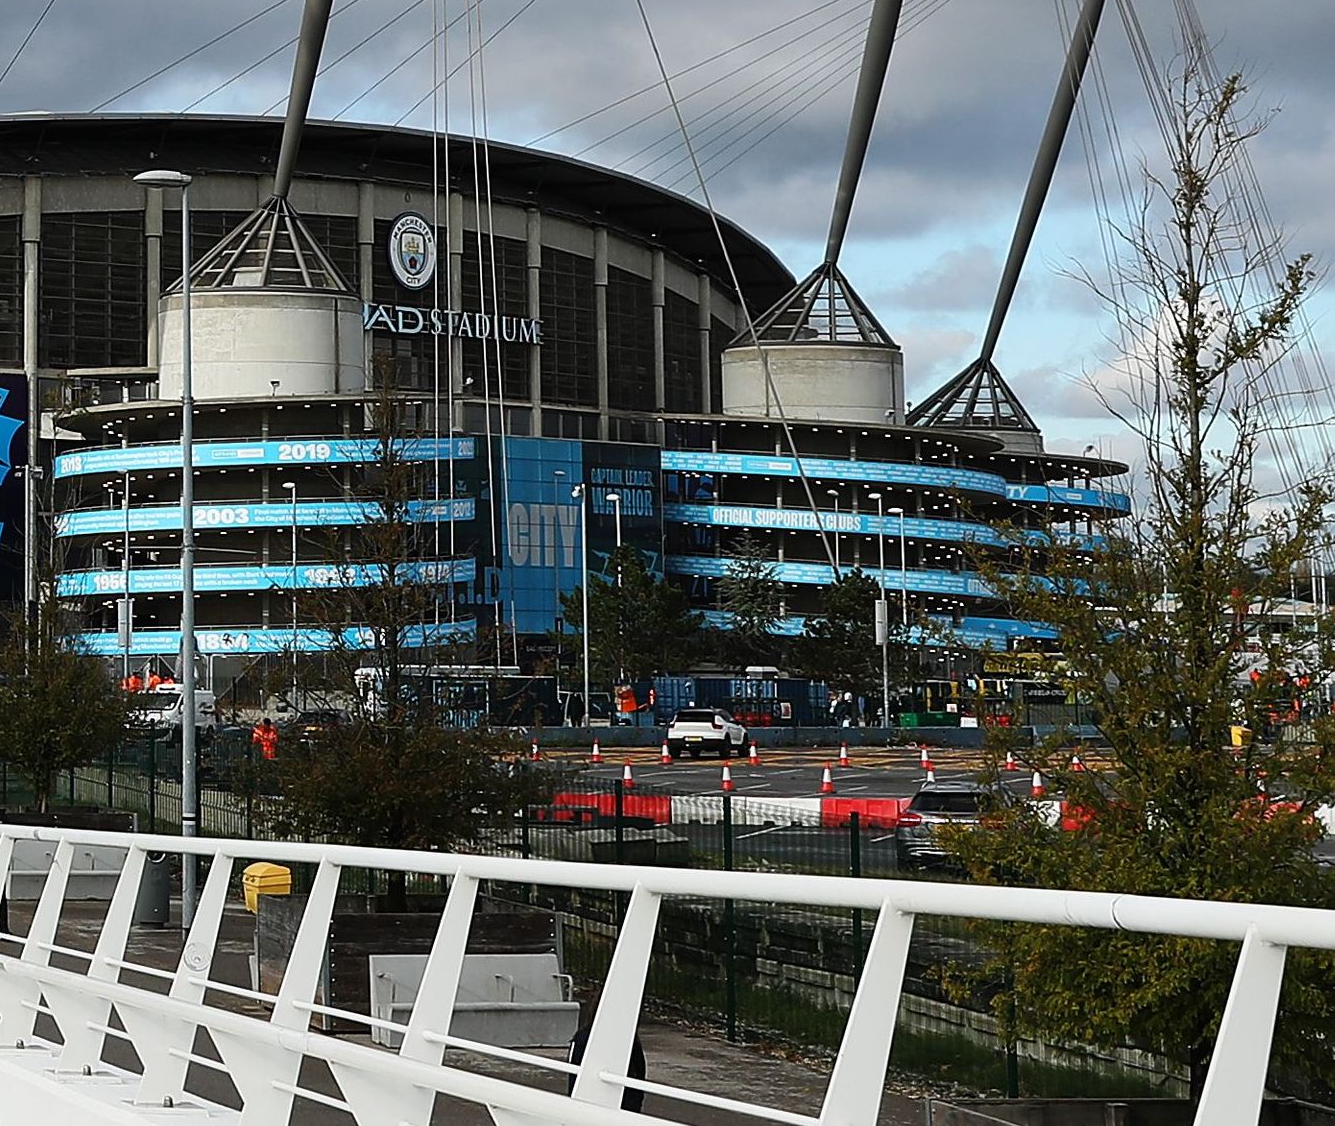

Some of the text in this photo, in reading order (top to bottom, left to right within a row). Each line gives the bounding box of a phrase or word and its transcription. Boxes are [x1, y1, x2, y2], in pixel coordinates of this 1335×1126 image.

[406, 276, 421, 285] CITY
[431, 309, 539, 344] STADIUM
[279, 443, 330, 461] 2019
[625, 470, 654, 487] LEADER
[592, 487, 653, 516] WARRIOR
[194, 508, 249, 525] 2003
[713, 508, 753, 525] OFFICIAL
[826, 515, 861, 531] CLUBS
[509, 503, 579, 567] CITY
